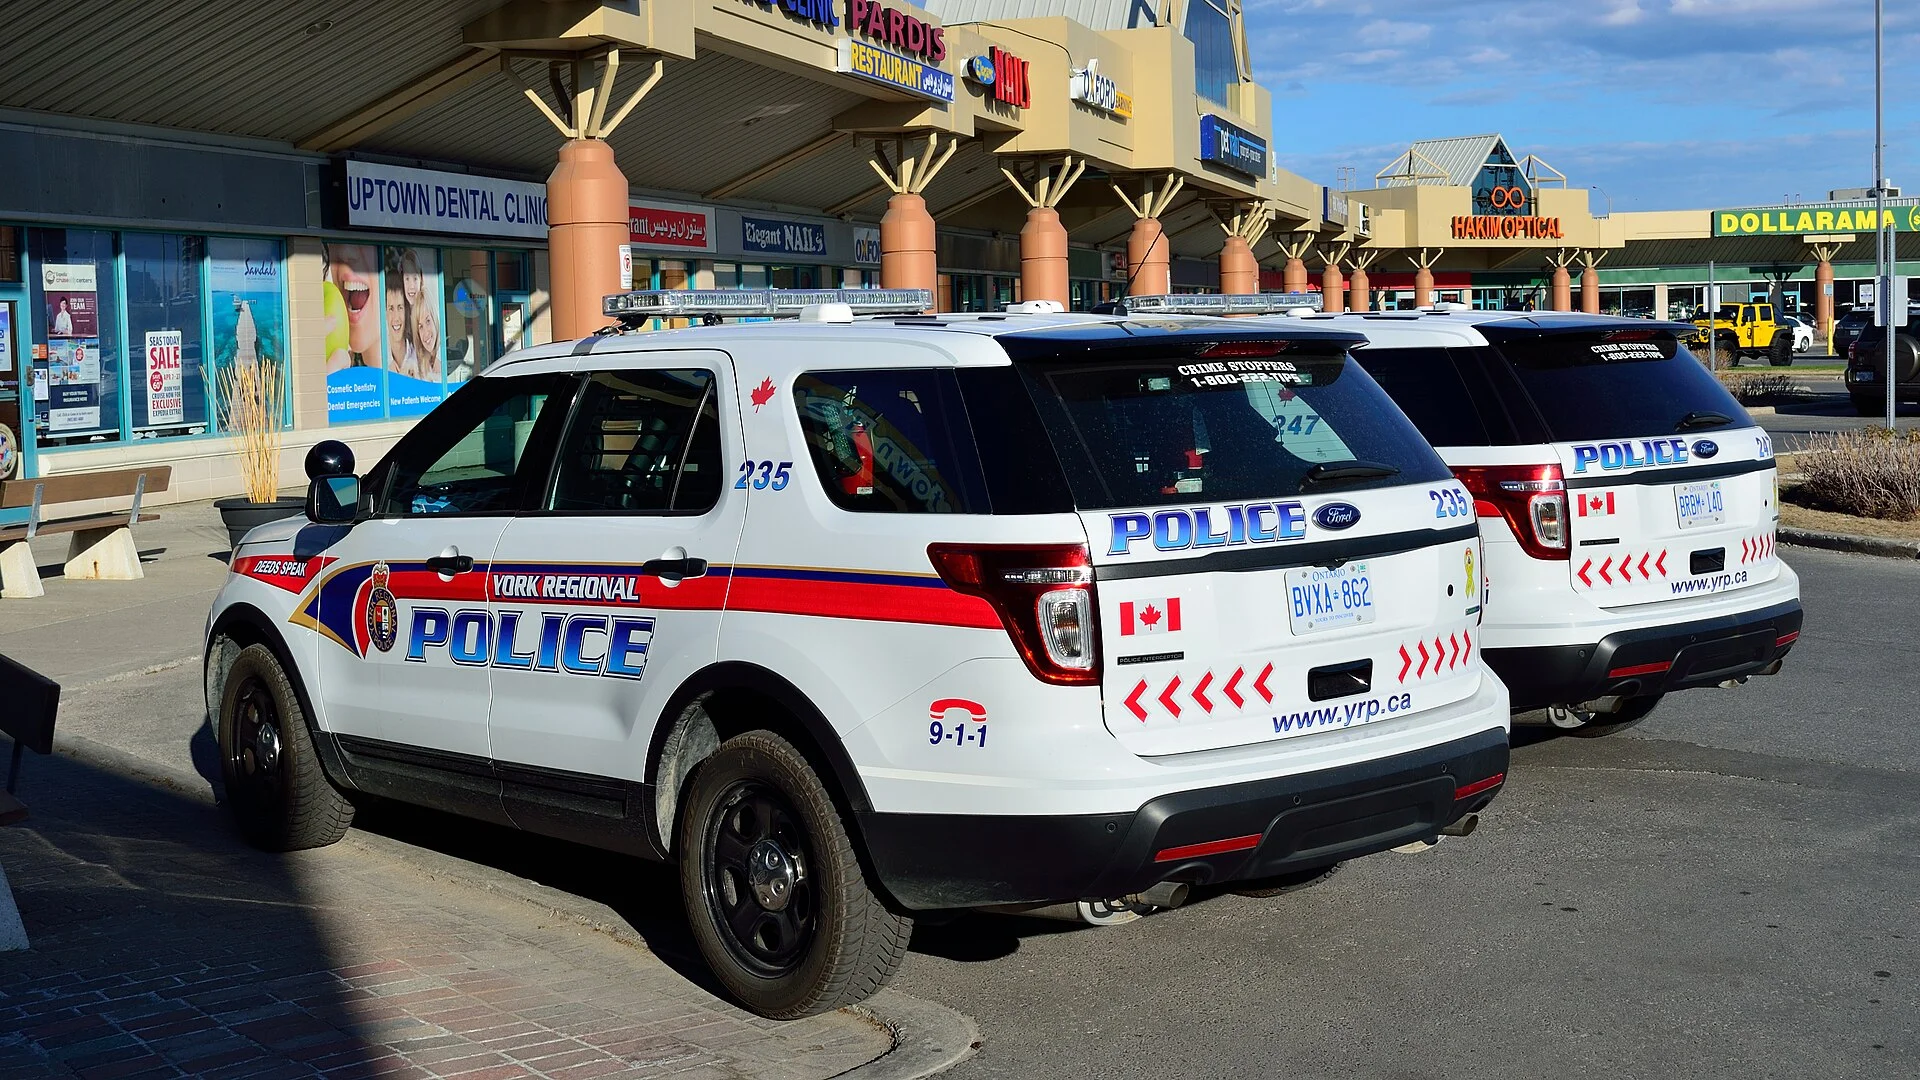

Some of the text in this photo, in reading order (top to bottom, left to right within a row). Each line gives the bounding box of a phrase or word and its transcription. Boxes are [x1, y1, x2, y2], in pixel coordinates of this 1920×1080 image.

[853, 0, 947, 61] PARDIS
[852, 42, 923, 89] RESTAURANT
[1084, 64, 1116, 109] OXFORD
[1220, 127, 1230, 159] pet
[349, 176, 431, 216] UPTOWN
[435, 184, 500, 222] DENTAL
[629, 216, 649, 234] rant
[1452, 216, 1565, 239] HAKIM OPTICAL
[1720, 209, 1898, 233] DOLLARAMA
[745, 222, 780, 249] Elegant
[856, 231, 880, 262] OXFO
[244, 257, 276, 276] Sandals
[150, 335, 180, 346] SEAS TODAY
[1590, 343, 1660, 354] CRIME STOPPERS
[150, 346, 180, 370] SALE
[1178, 361, 1297, 376] CRIME STOPPERS
[327, 384, 377, 394] Cosmetic Dentistry
[1191, 373, 1302, 388] 1-800-222-TIPS
[152, 399, 182, 409] EXCLUSIVE
[328, 400, 381, 411] Dental Emergencies
[390, 395, 442, 406] New Patients Welcome
[1272, 415, 1320, 436] 247
[1573, 437, 1689, 474] POLICE
[1700, 443, 1716, 455] Ford
[1756, 436, 1773, 457] 247
[734, 460, 793, 491] 235
[1429, 489, 1469, 519] 235
[1706, 490, 1723, 512] 140
[1326, 506, 1352, 524] Ford
[1107, 501, 1306, 556] POLICE
[253, 561, 307, 577] DEEDS SPEAK
[1312, 568, 1346, 582] ONTARIO
[493, 574, 641, 601] YORK REGIONAL
[1671, 570, 1748, 594] www.yrp.ca
[1292, 577, 1372, 618] BVXA 862
[405, 606, 658, 681] POLICE
[1272, 692, 1412, 733] www.yrp.ca
[929, 721, 987, 748] 9-1-1
